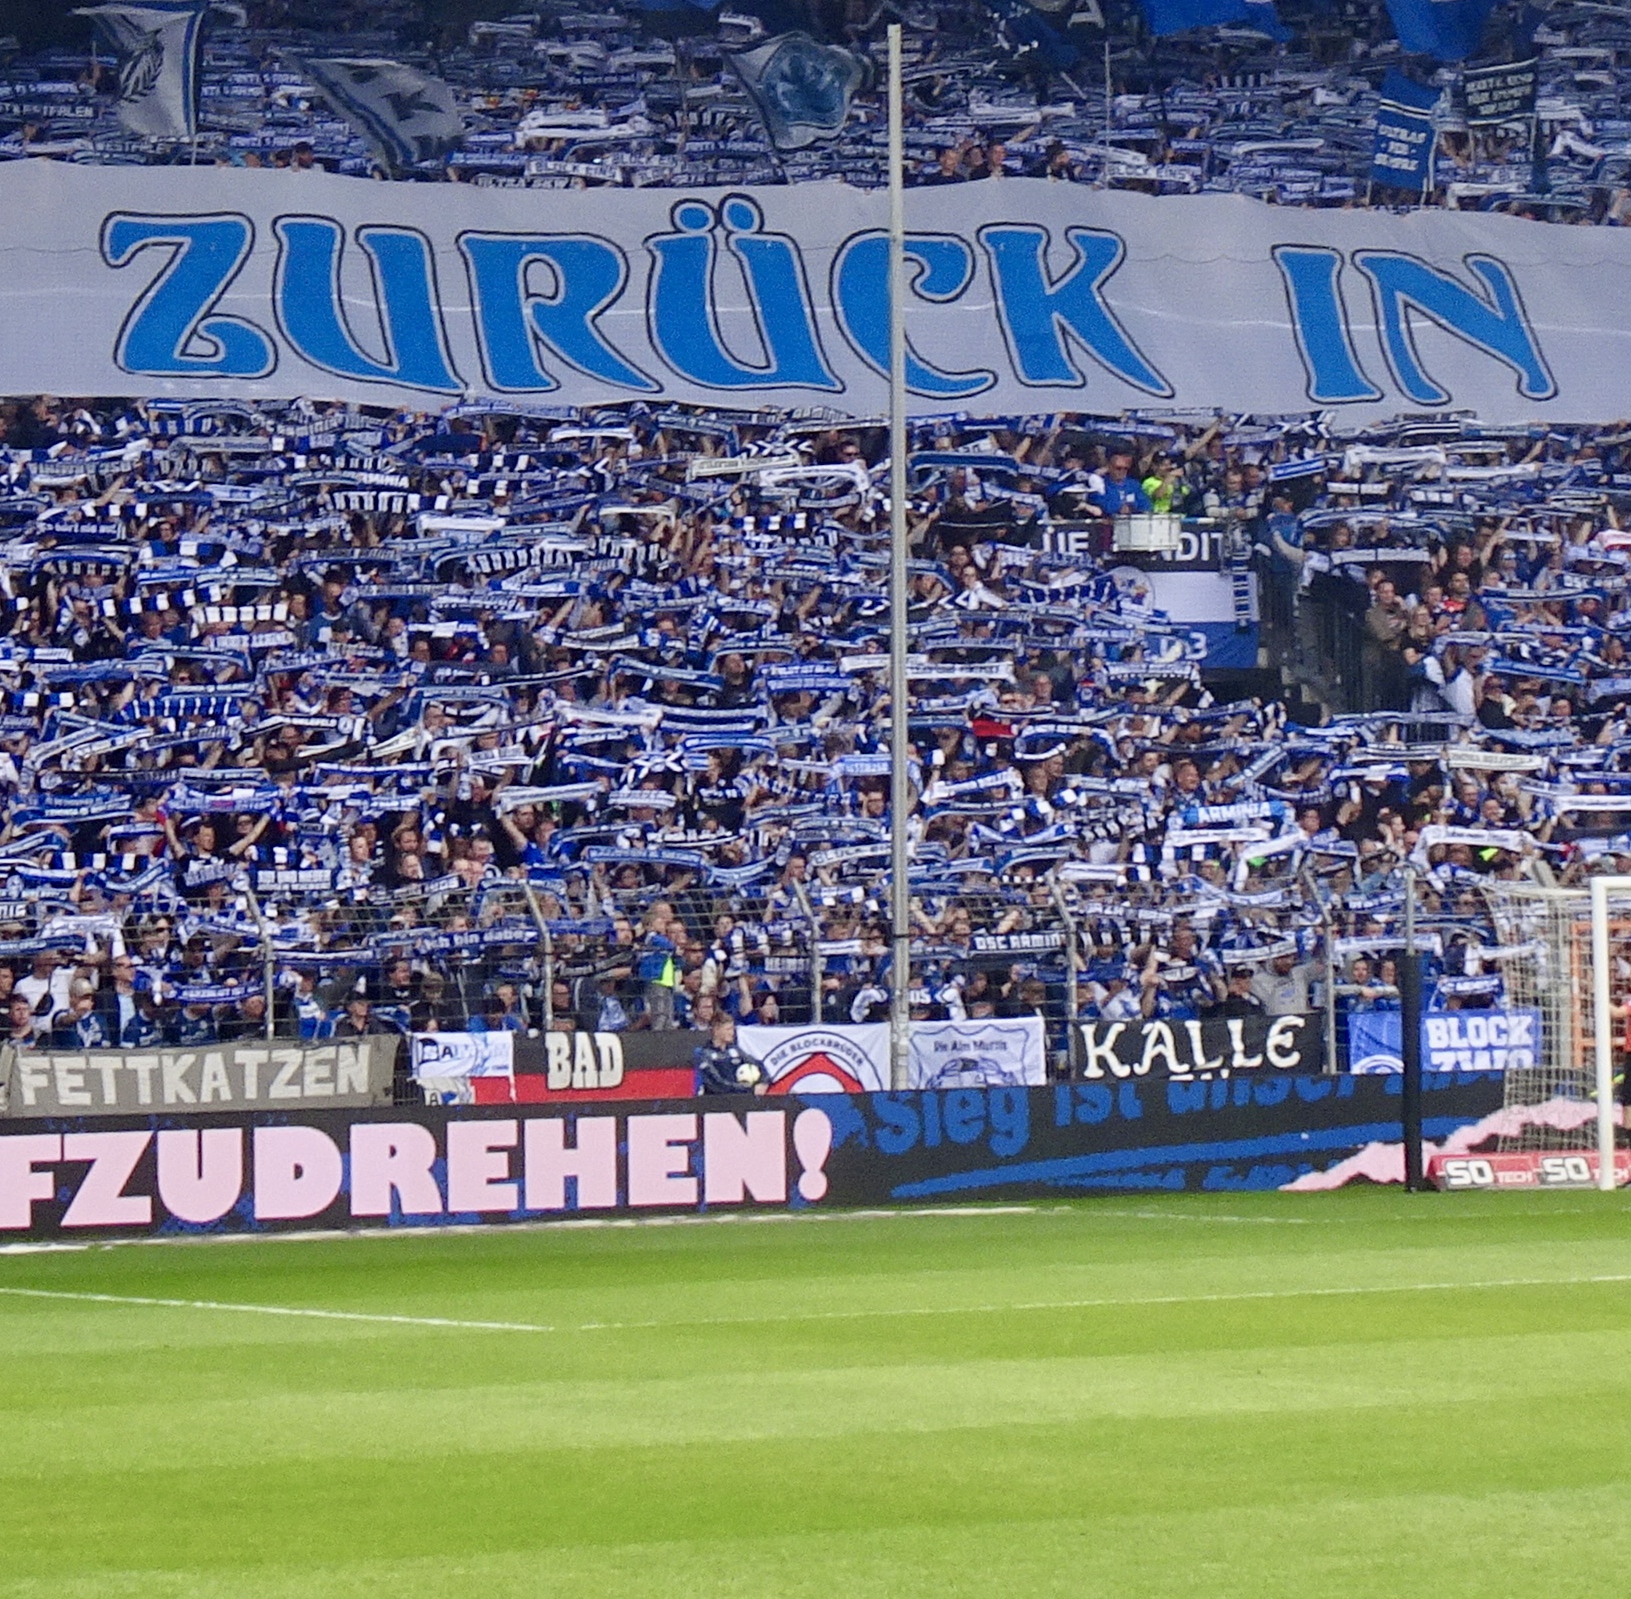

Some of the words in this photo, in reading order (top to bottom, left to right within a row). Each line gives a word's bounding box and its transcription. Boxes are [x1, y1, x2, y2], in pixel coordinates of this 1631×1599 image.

[98, 192, 1175, 400] ZURÜCK
[1270, 244, 1558, 406] IN
[1079, 1015, 1306, 1079] KALLE
[1425, 1016, 1534, 1049] BLOCK
[18, 1045, 371, 1107] FETTKATZEN
[545, 1031, 625, 1091] BAD
[770, 1050, 788, 1066] DIE
[1445, 1160, 1495, 1186] SO
[1496, 1170, 1533, 1185] TECH
[1542, 1156, 1591, 1182] SO
